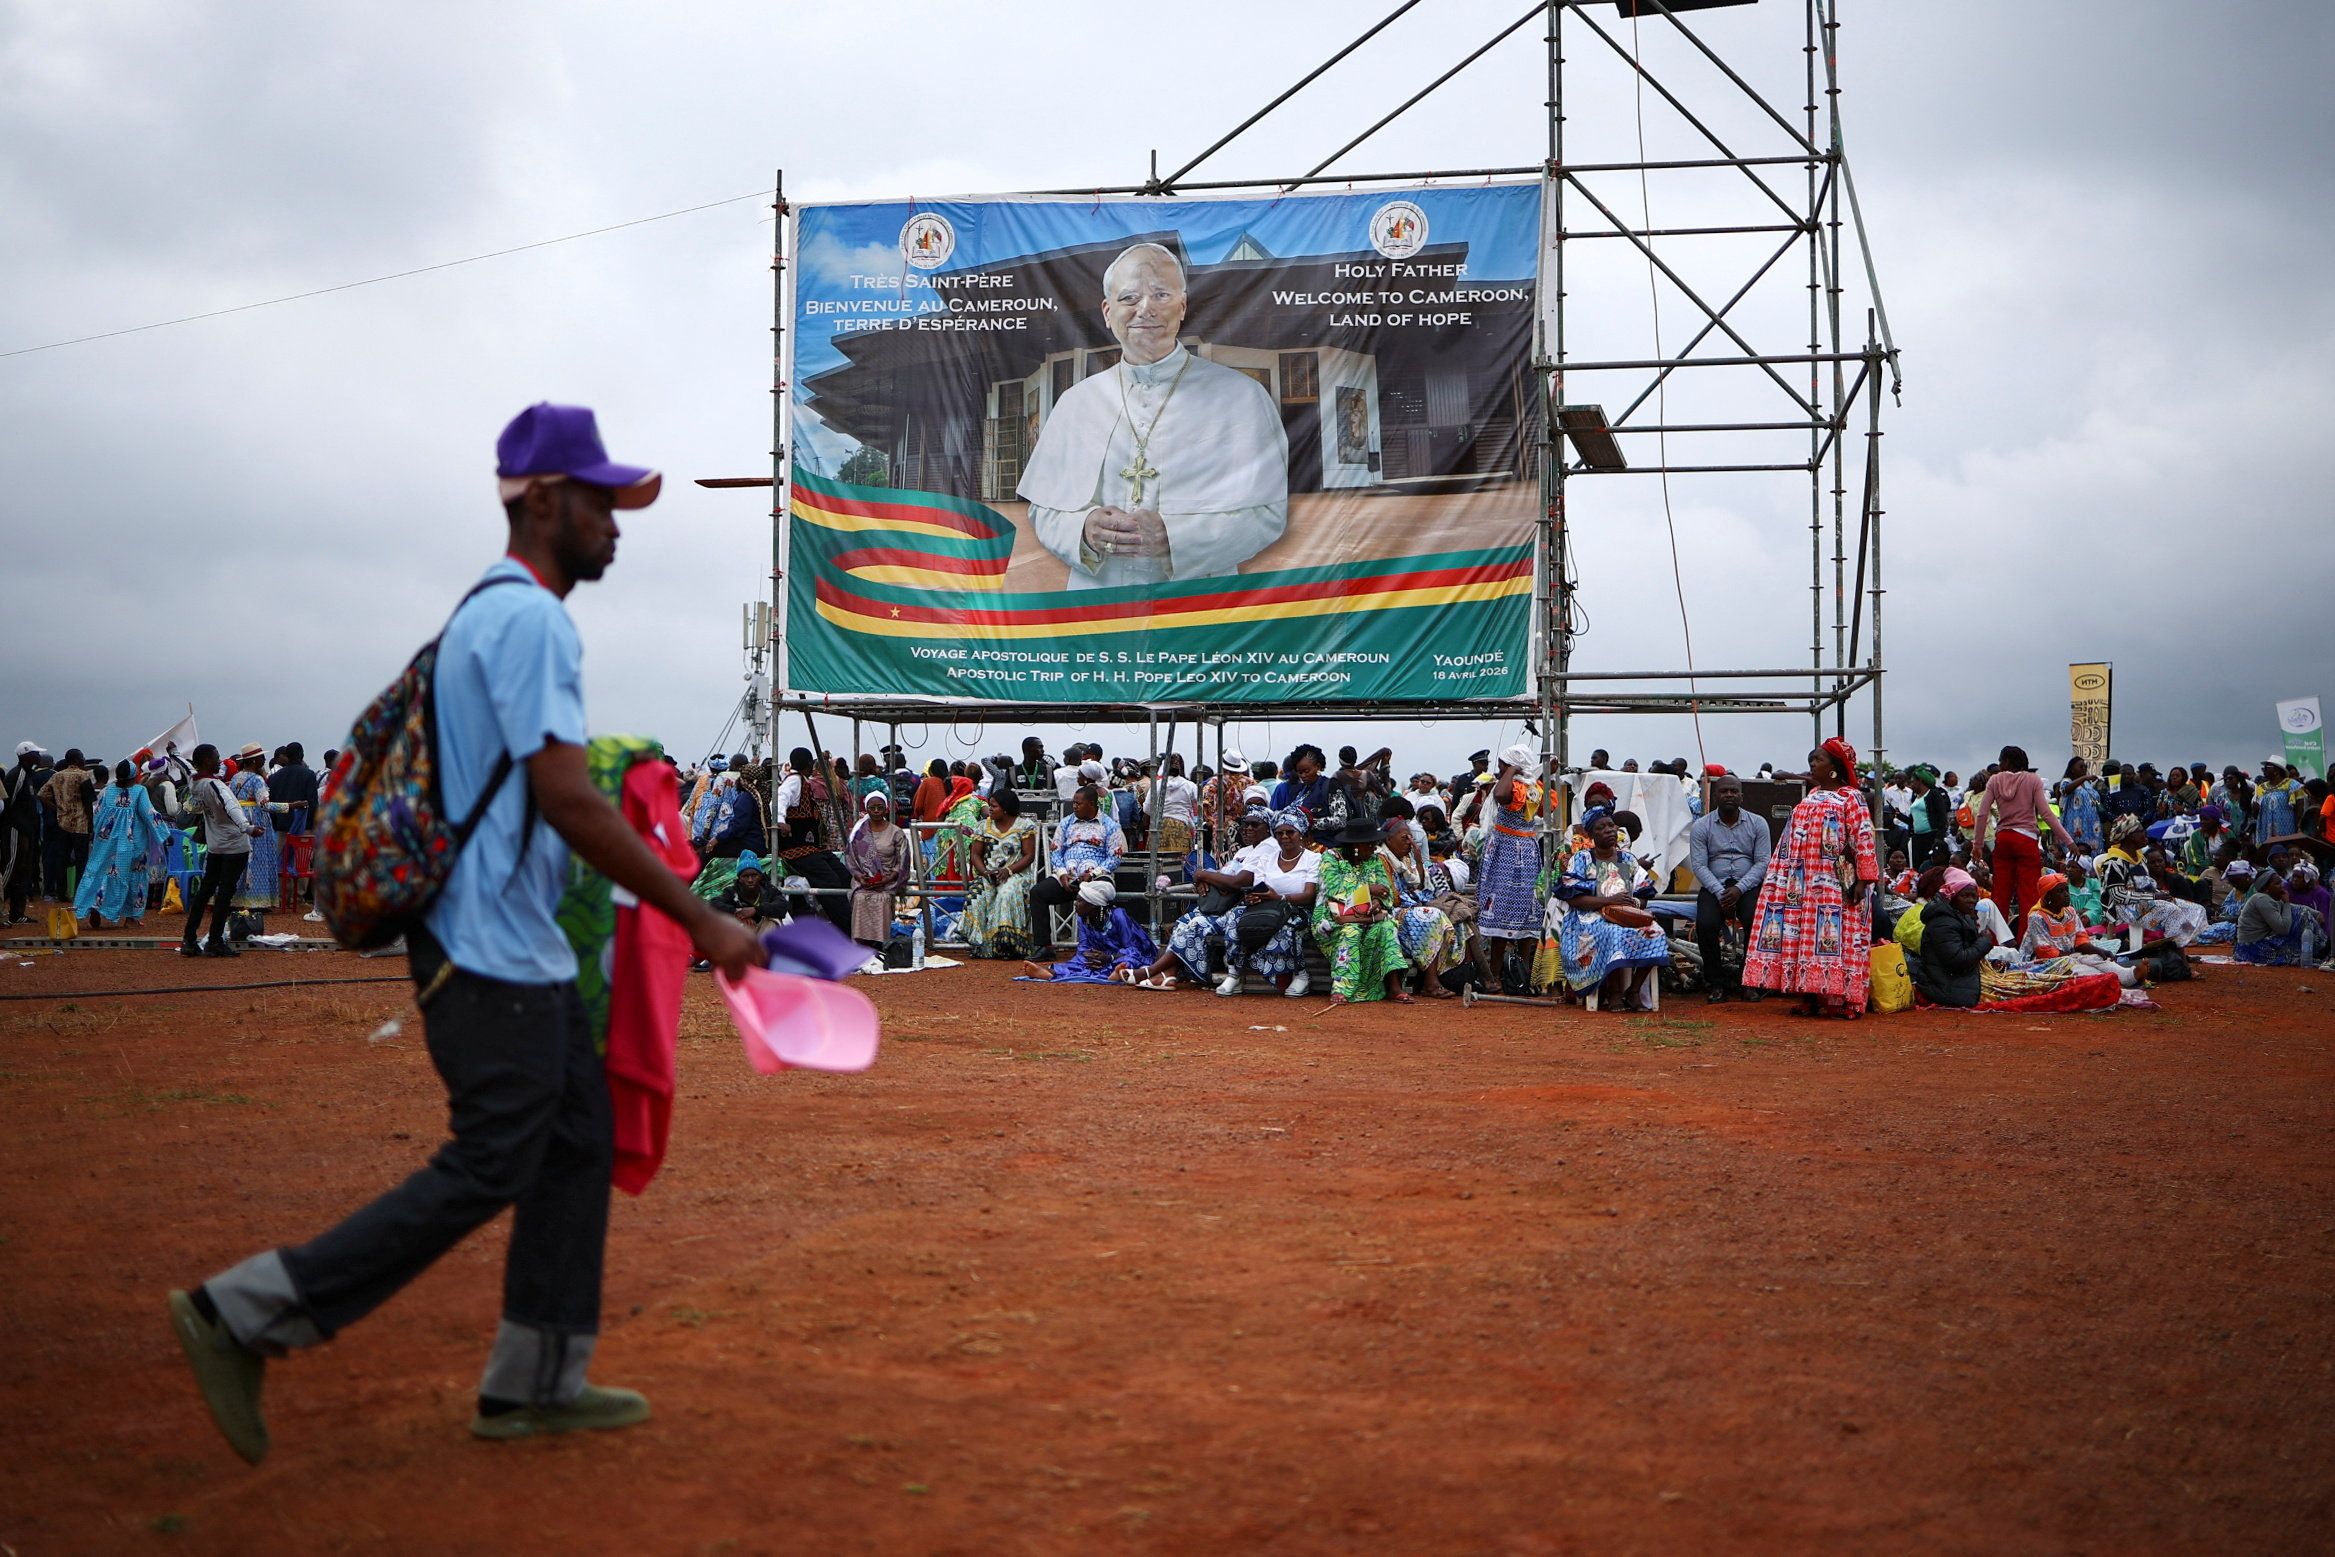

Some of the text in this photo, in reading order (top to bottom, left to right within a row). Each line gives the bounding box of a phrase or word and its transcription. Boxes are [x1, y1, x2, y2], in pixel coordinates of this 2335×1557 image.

[1334, 262, 1468, 278] HOLY FATHER
[850, 272, 1014, 289] TRÈS SAINT-PÈRE
[1271, 288, 1529, 305] WELCOME TO CAMEROON,
[805, 297, 1059, 315] BIENVENUE AU CAMEROUN,
[833, 318, 893, 331] TERRE
[1329, 312, 1472, 327] LAND OF HOPE
[910, 646, 968, 660] VOYAGE
[971, 650, 1069, 664] APOSTOLIQUE
[1076, 652, 1095, 663] DE
[1136, 651, 1155, 664] LE
[1158, 652, 1198, 664] PAPE
[1246, 652, 1275, 664] XIV
[1278, 653, 1299, 664] AU
[1303, 652, 1390, 664] CAMEROUN
[1432, 648, 1504, 667] YAOUNDÉ
[946, 666, 1027, 681] APOSTOLIC
[1030, 669, 1064, 682] TRIP
[1070, 672, 1090, 682] OF
[1134, 671, 1173, 683] POPE
[1176, 671, 1207, 683] LEO
[1210, 671, 1238, 683] XIV
[1241, 673, 1261, 683] TO
[1264, 671, 1351, 683] CAMEROON
[1432, 666, 1509, 680] 18 AVRIL 2026
